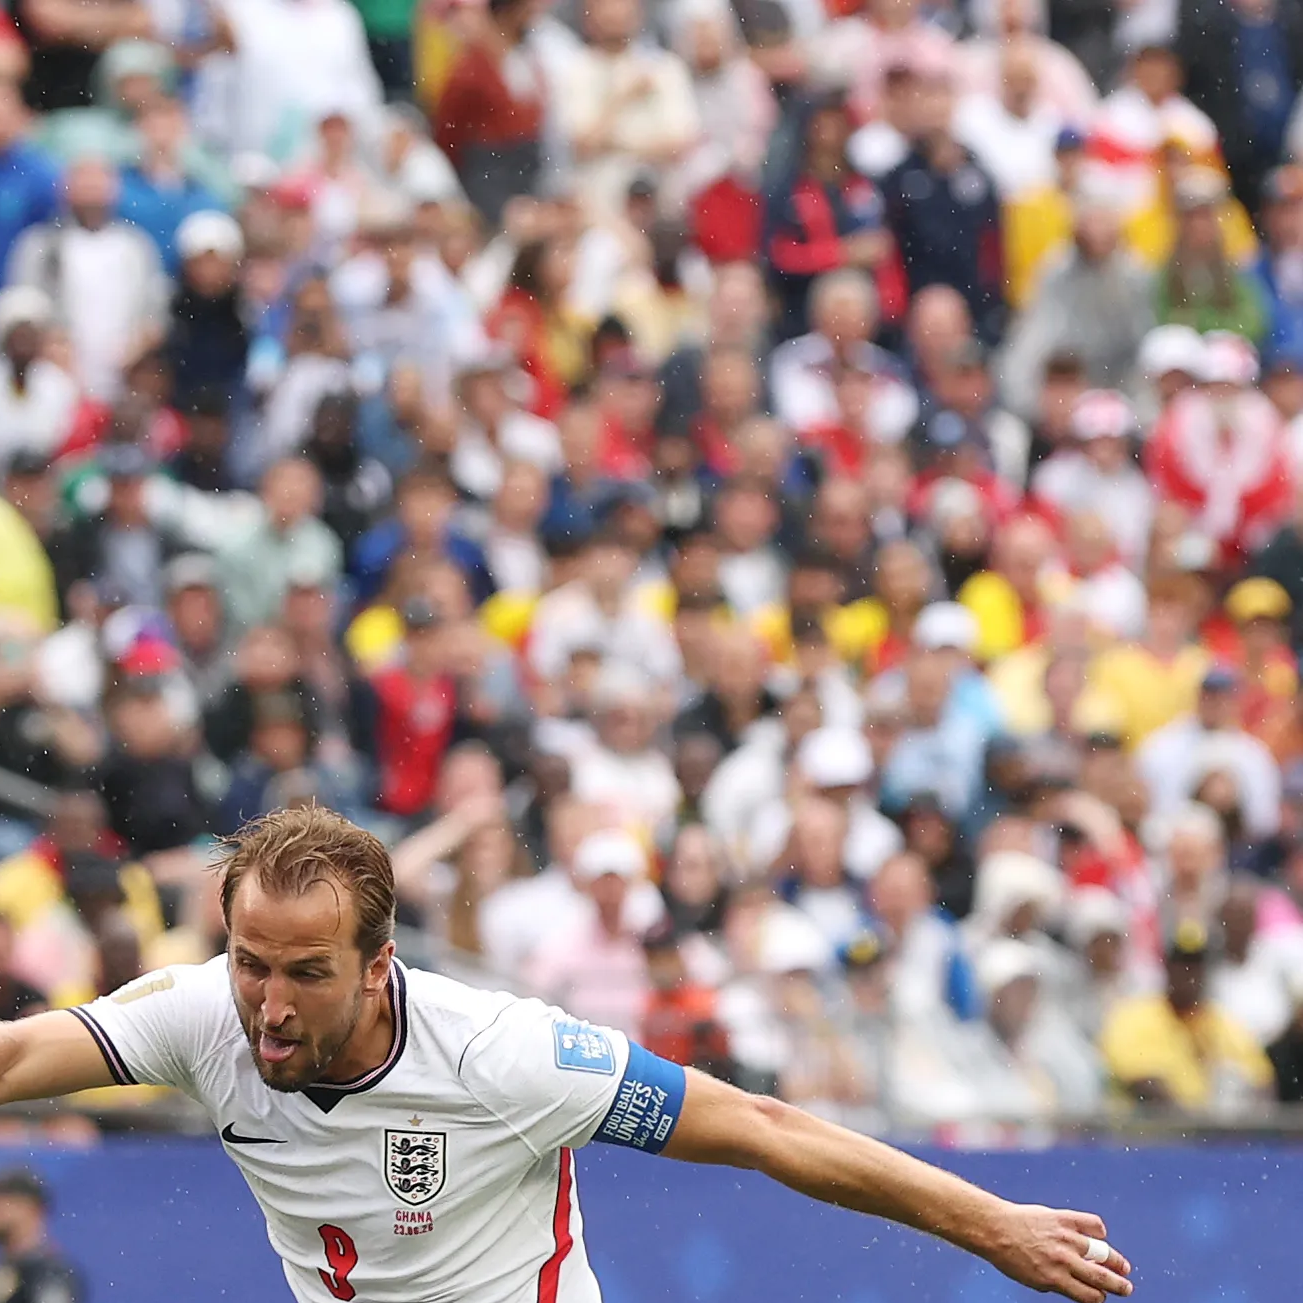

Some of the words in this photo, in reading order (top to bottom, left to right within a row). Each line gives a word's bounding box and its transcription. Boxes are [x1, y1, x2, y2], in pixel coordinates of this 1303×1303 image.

[603, 1079, 637, 1137] FOOTBALL
[615, 1082, 652, 1141] UNITES
[641, 1085, 669, 1131] World
[656, 1116, 672, 1140] FIFA
[395, 1210, 433, 1223] GHANA
[316, 1223, 359, 1302] 9
